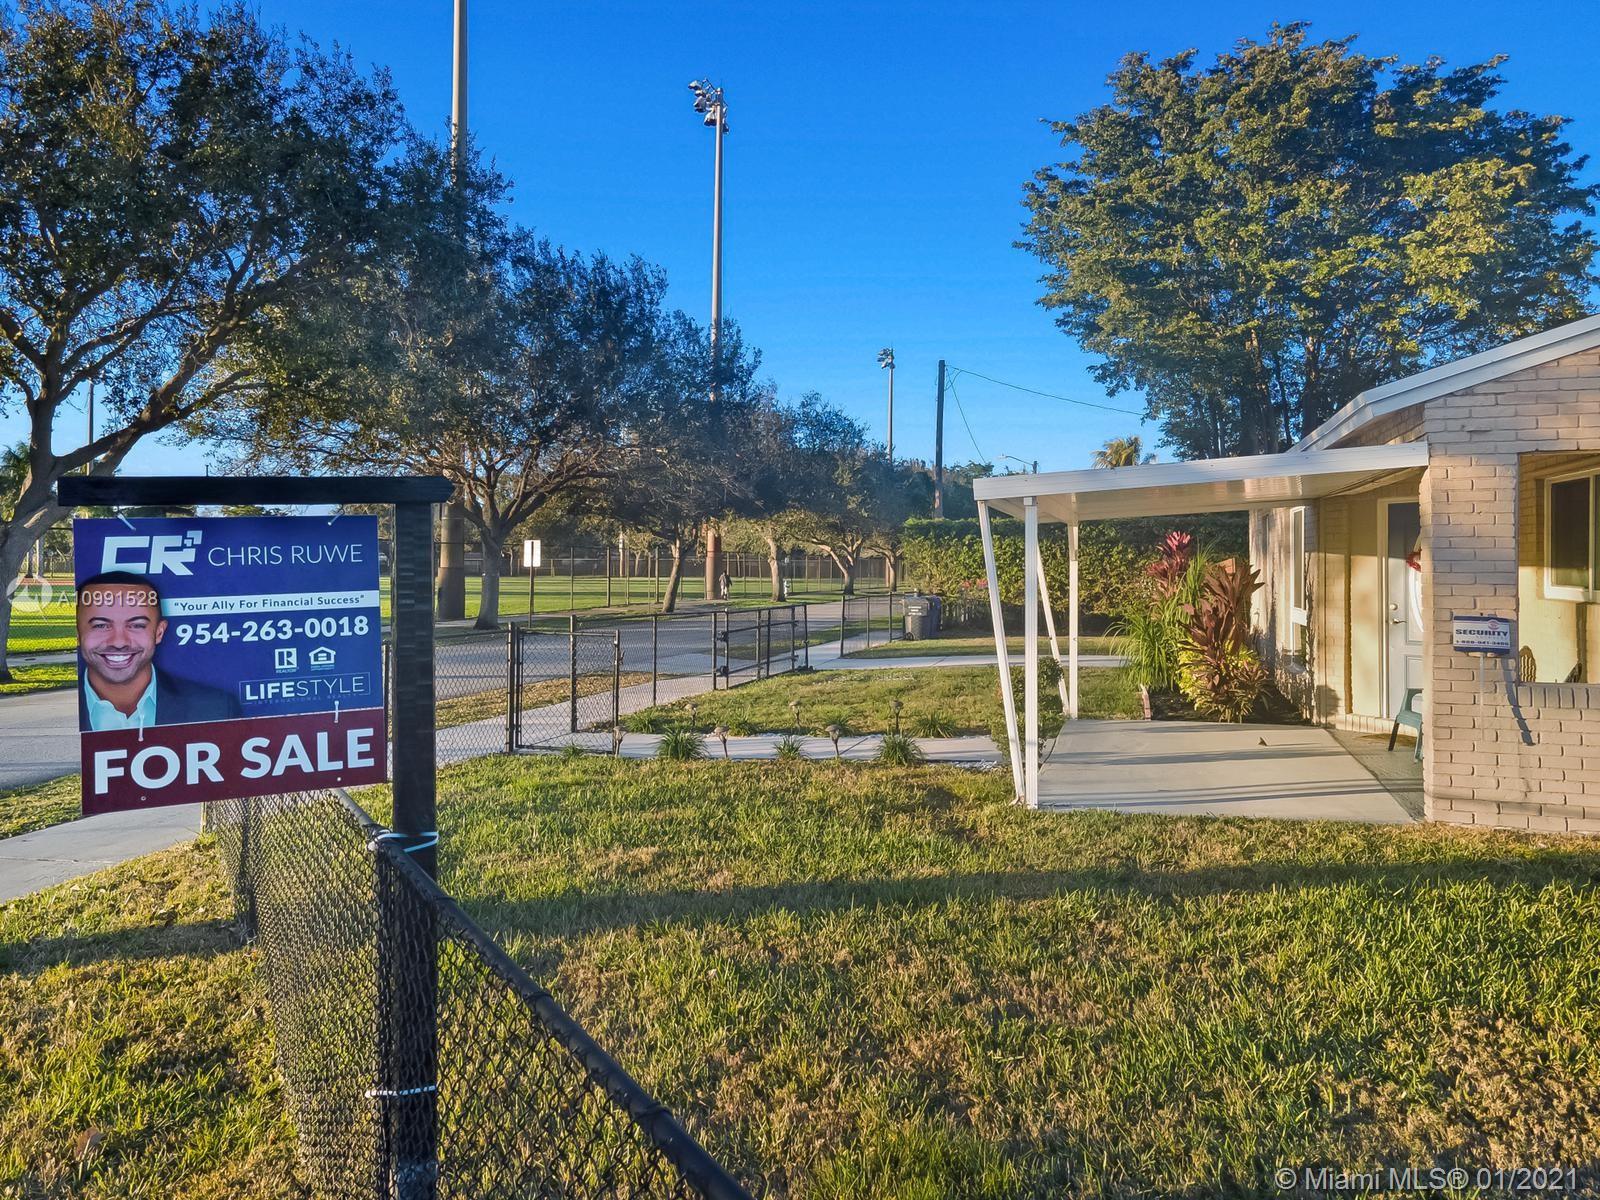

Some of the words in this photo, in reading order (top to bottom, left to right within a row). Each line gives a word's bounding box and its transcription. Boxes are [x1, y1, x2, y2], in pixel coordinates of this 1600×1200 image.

[208, 546, 283, 567] CHRIS
[291, 544, 363, 564] RUWE
[174, 601, 208, 612] "Your
[212, 598, 234, 611] Ally
[239, 599, 258, 609] For
[262, 596, 313, 608] Financial
[317, 594, 365, 606] Success"
[175, 615, 369, 646] 954-263-0018
[1455, 628, 1508, 637] SECURITY
[245, 676, 365, 700] LIFESTYLE
[94, 742, 225, 795] FOR
[240, 728, 375, 779] SALE
